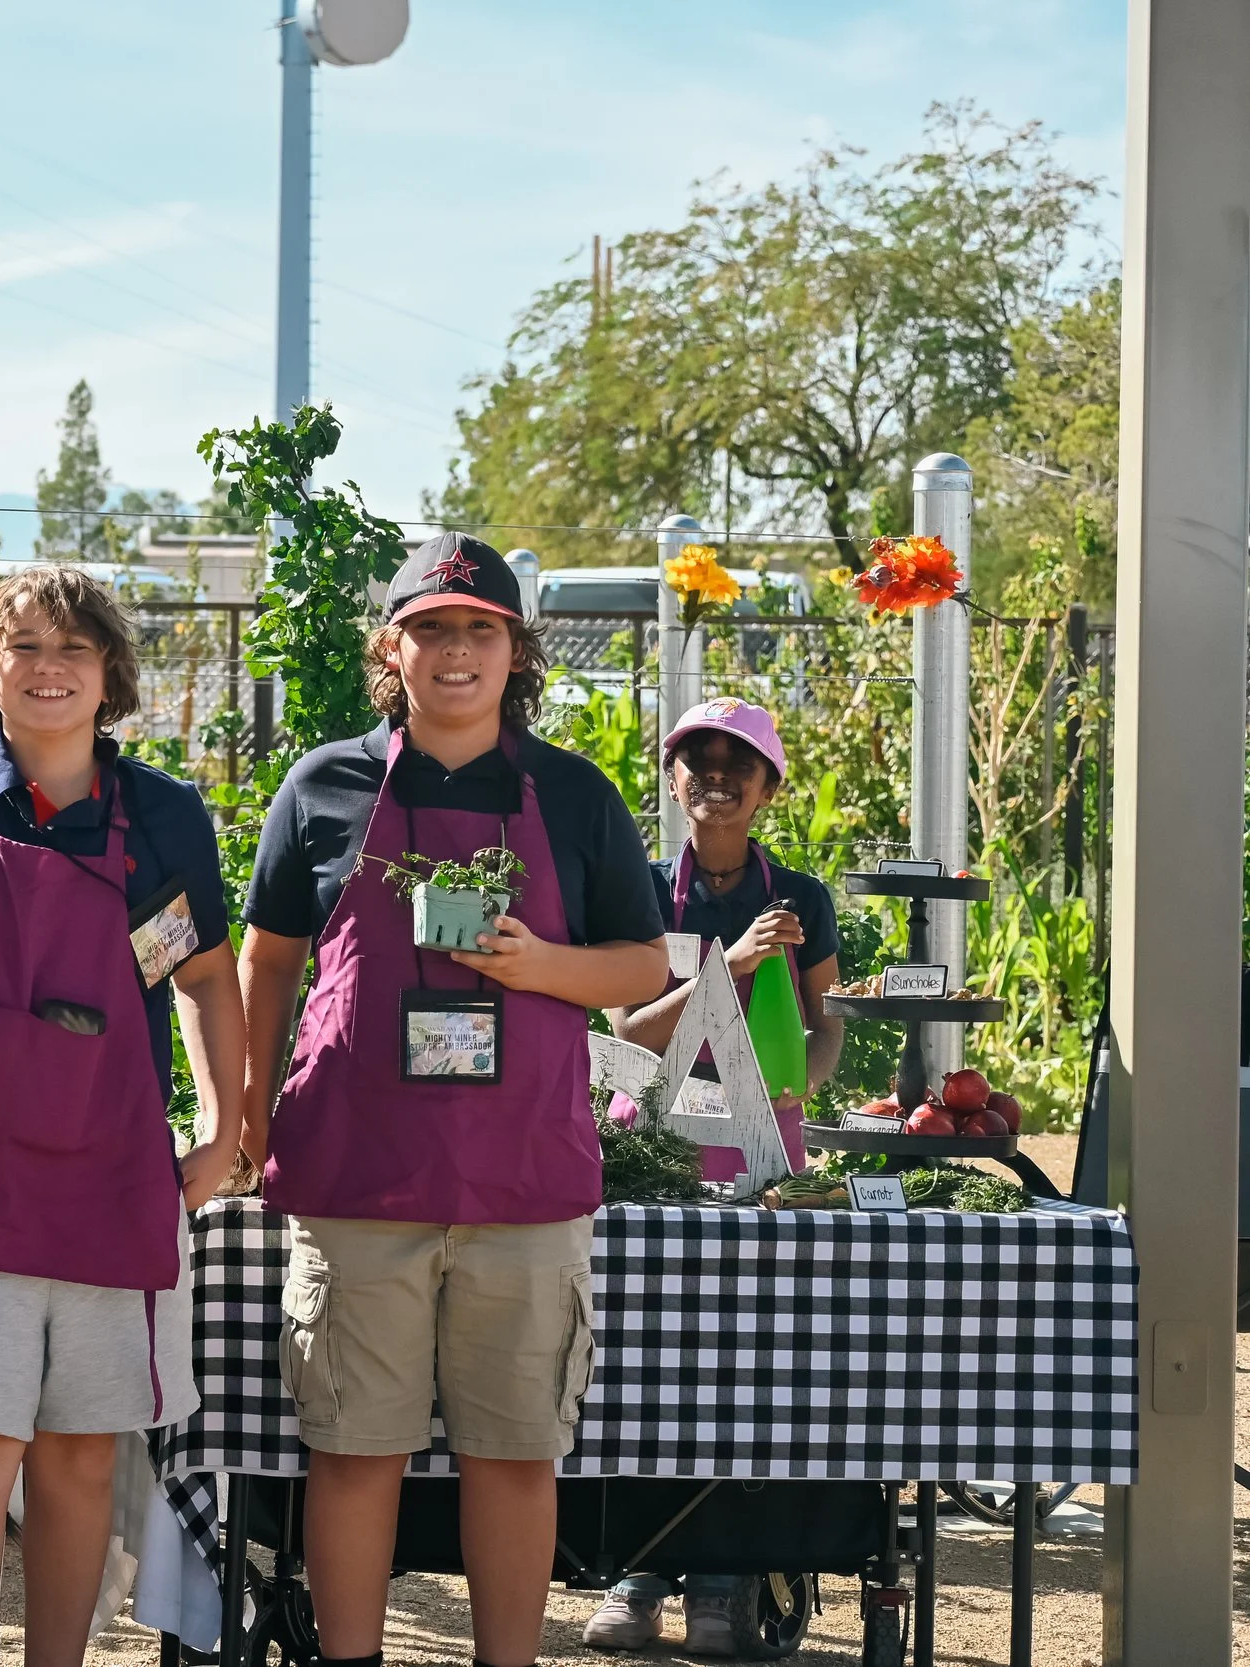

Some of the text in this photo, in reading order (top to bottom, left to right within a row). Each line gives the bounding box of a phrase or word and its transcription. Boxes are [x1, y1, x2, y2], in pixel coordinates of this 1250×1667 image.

[425, 1034, 478, 1043] MIGHTY MINER
[444, 1042, 492, 1051] AMBASSADOR
[860, 1186, 893, 1201] Carrots
